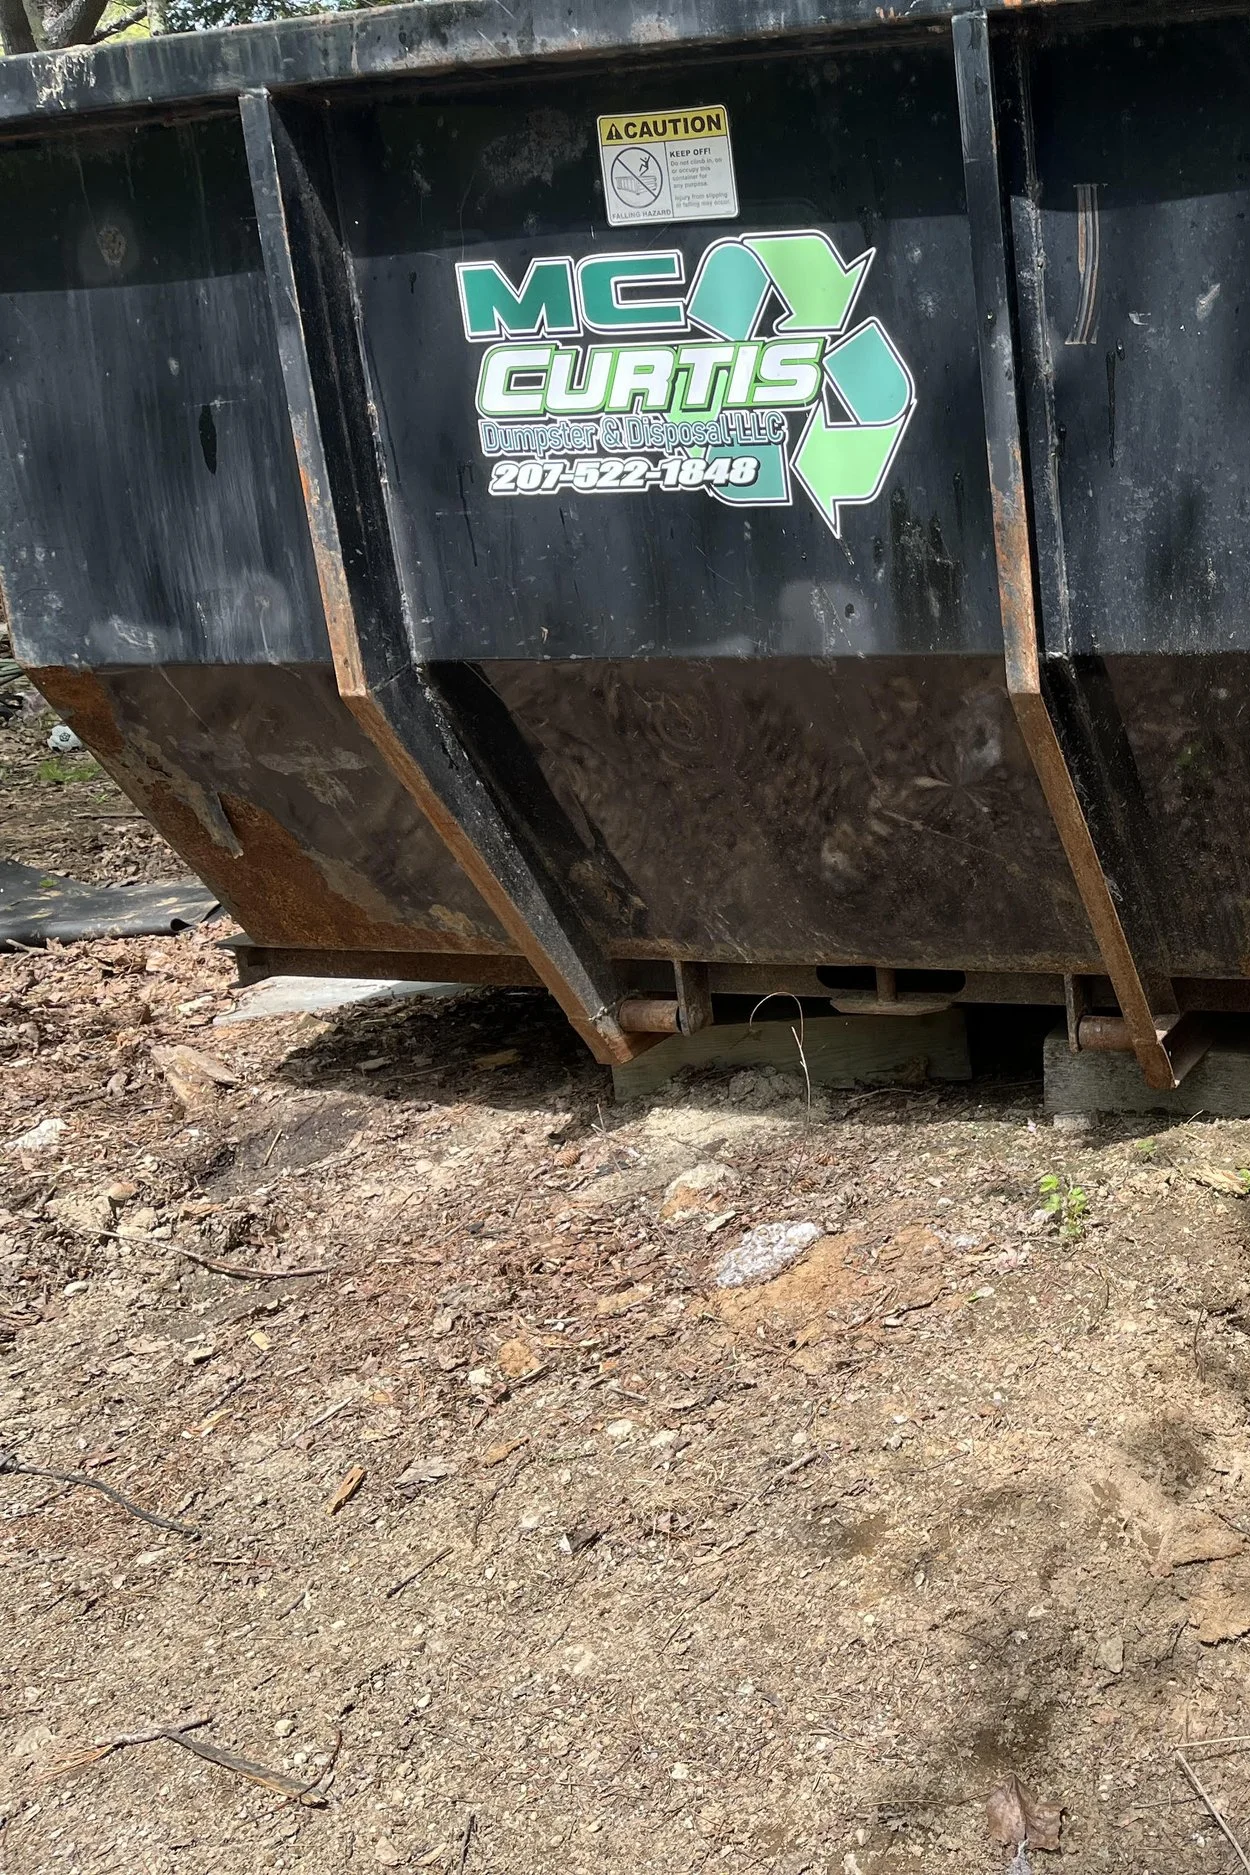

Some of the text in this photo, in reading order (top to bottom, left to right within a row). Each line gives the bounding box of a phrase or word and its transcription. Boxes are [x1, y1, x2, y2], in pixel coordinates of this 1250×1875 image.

[624, 113, 722, 139] CAUTION
[669, 147, 711, 158] KEEP OFF!
[612, 209, 672, 220] FALLING HAZARD
[457, 251, 688, 339] MC
[479, 338, 826, 415] CURTIS
[481, 410, 786, 456] Dumpster & Disposal LLC
[490, 455, 762, 491] 207-522-1848
